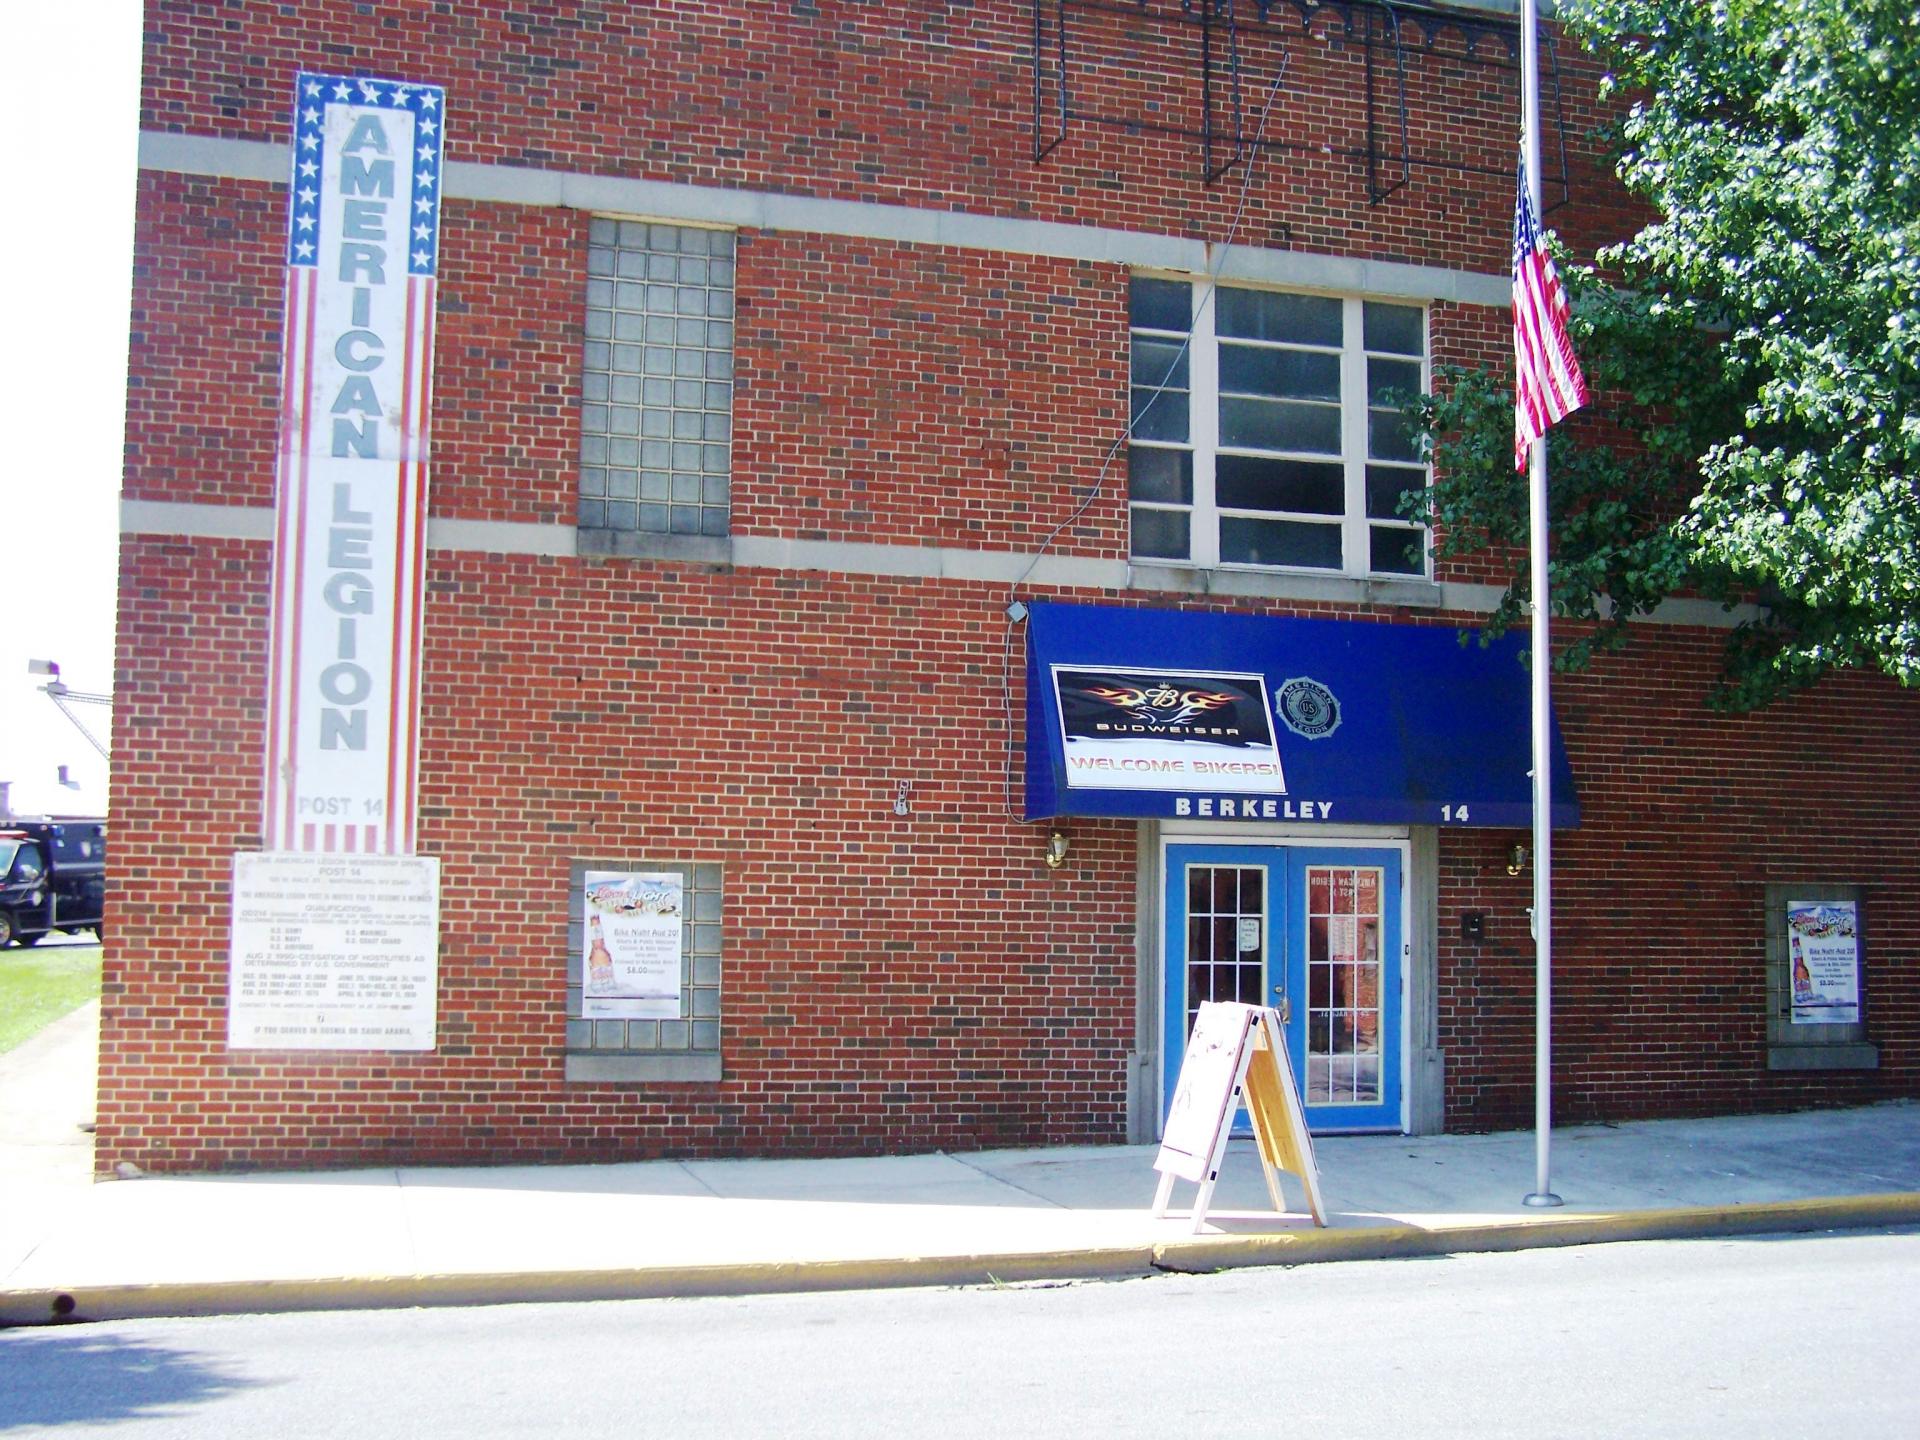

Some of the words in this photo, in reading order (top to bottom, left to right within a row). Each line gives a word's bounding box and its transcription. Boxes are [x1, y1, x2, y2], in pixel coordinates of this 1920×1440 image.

[329, 113, 395, 459] AMERICAN
[319, 482, 374, 751] LEGION
[1283, 681, 1333, 704] AMERICAN
[1302, 702, 1315, 713] US
[1096, 723, 1240, 736] BUDWEISER
[1292, 720, 1328, 734] LEGION
[1070, 757, 1185, 773] WELCOME
[1192, 761, 1279, 776] BIKERS!
[299, 797, 353, 816] POST
[363, 798, 384, 817] 14
[1175, 797, 1334, 820] BERKELEY
[1441, 804, 1470, 822] 14
[319, 867, 346, 876] POST
[632, 928, 650, 937] Night
